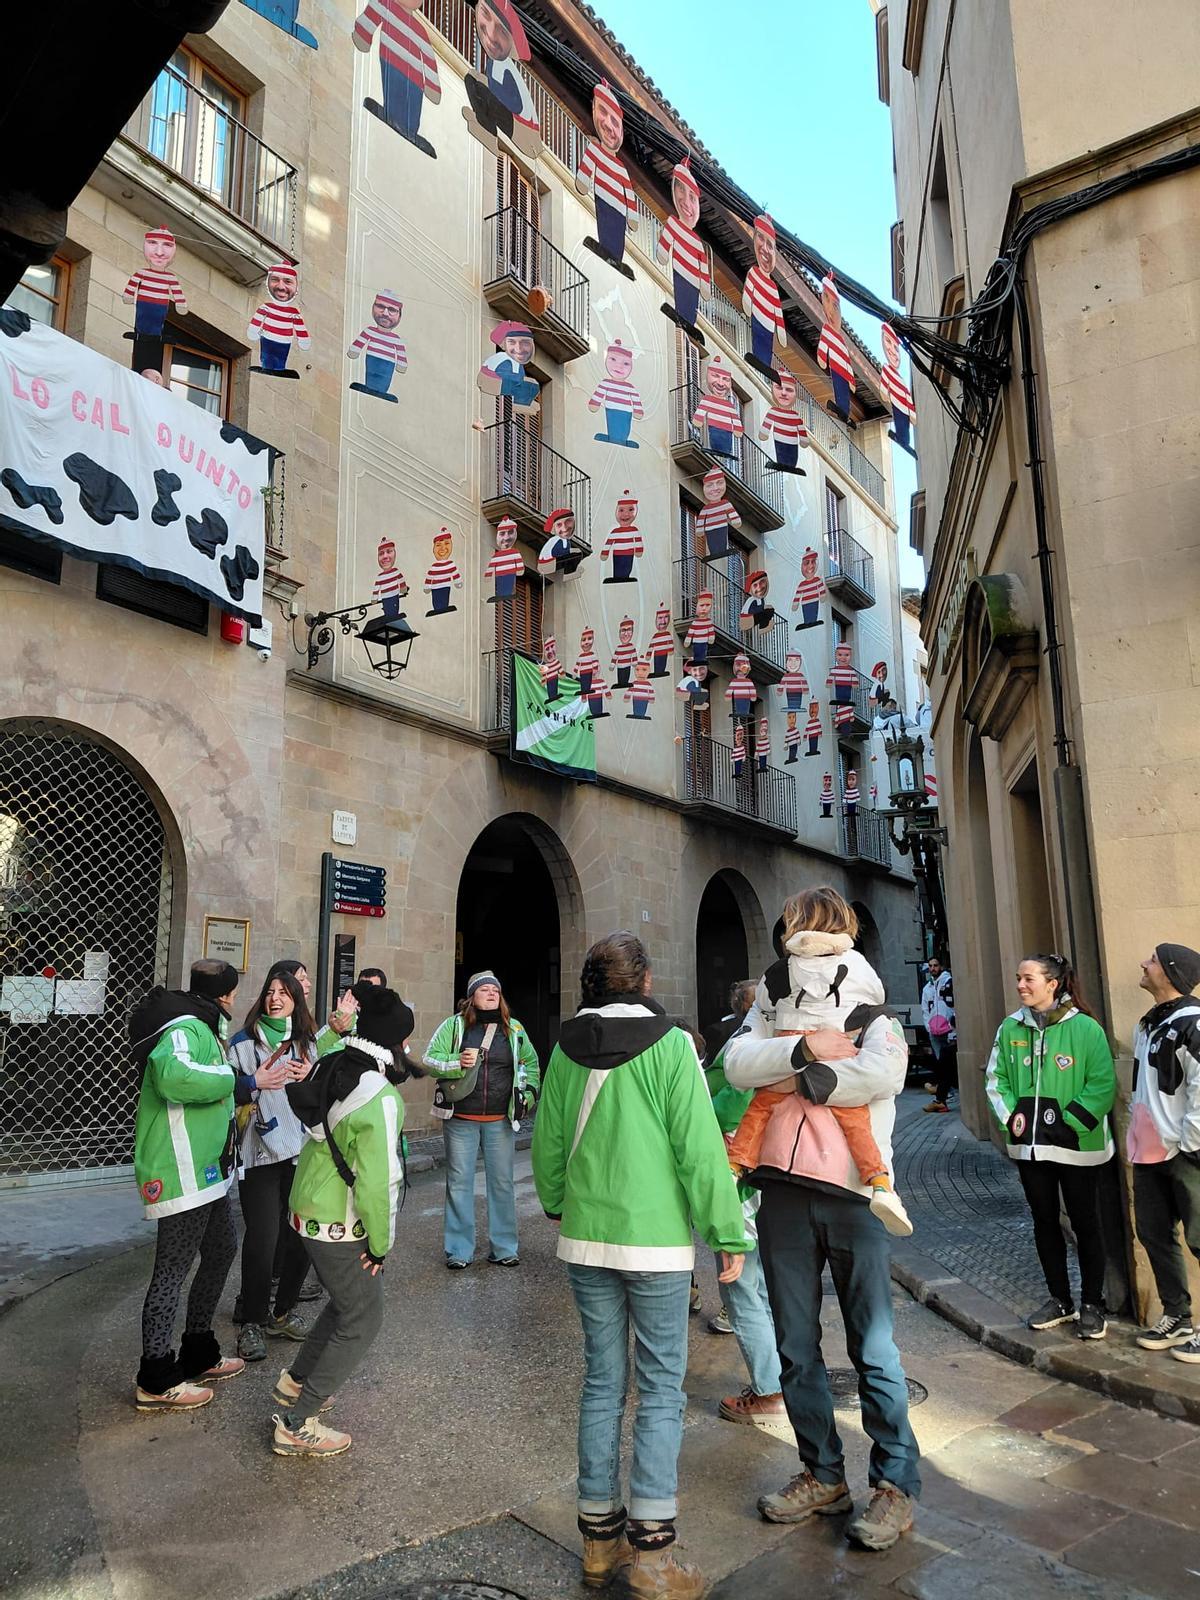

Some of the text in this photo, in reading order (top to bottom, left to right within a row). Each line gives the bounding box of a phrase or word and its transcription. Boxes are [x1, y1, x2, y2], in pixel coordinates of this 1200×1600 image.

[9, 364, 252, 510] LO CAL QUINTO
